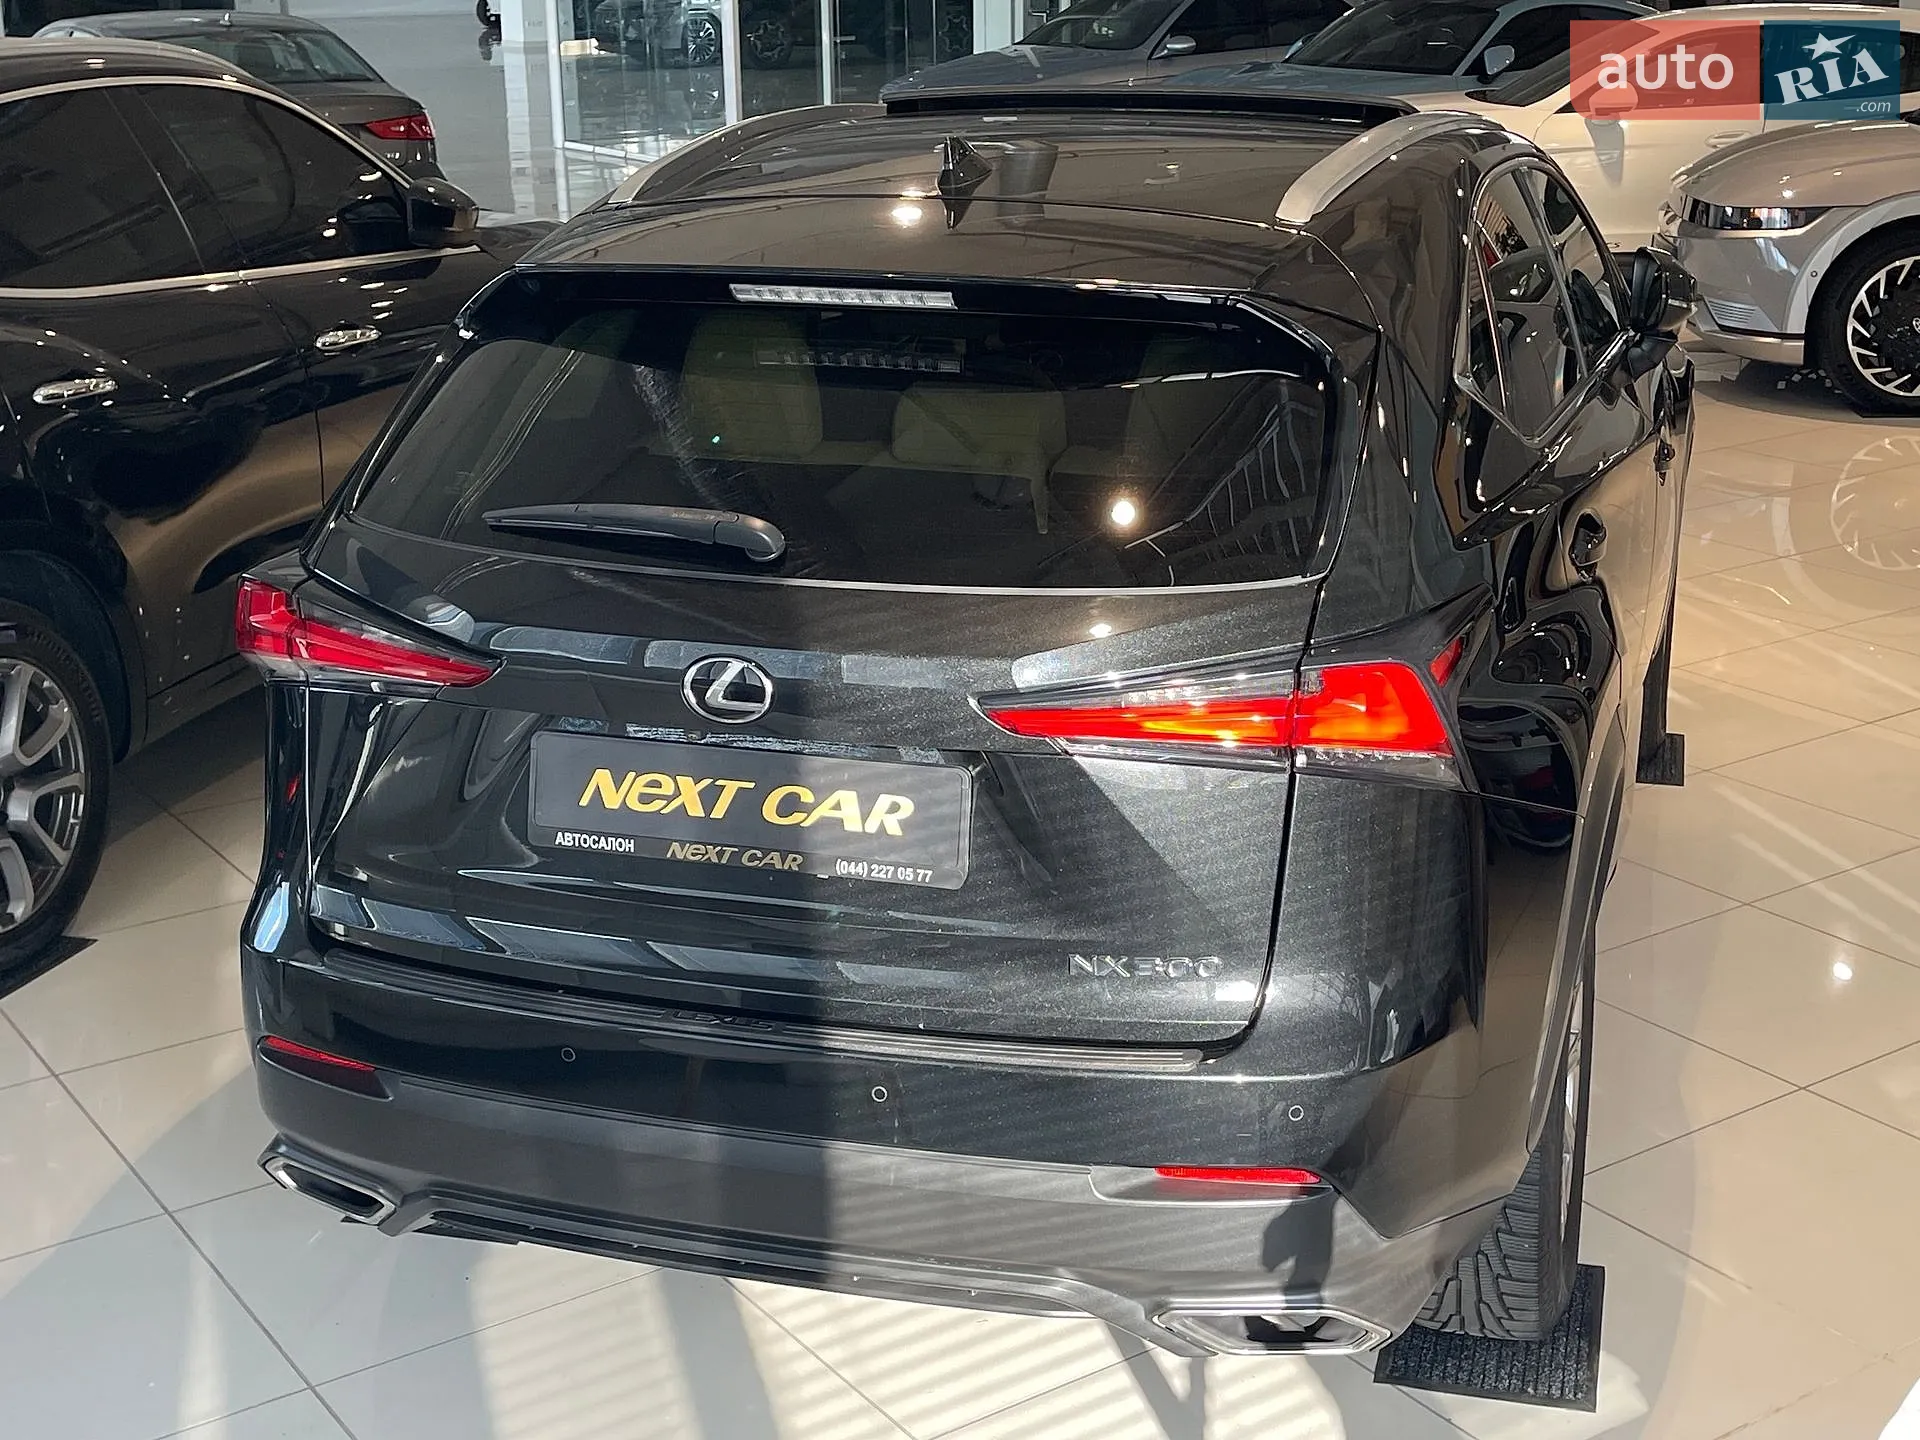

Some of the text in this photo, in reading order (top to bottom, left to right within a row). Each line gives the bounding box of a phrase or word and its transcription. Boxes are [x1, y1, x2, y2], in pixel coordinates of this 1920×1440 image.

[761, 786, 915, 836] CAR
[555, 831, 635, 853] АВТОСАЛОН
[741, 850, 804, 871] CAR
[835, 858, 933, 883] (044) 227 05 77
[1068, 954, 1130, 977] NX
